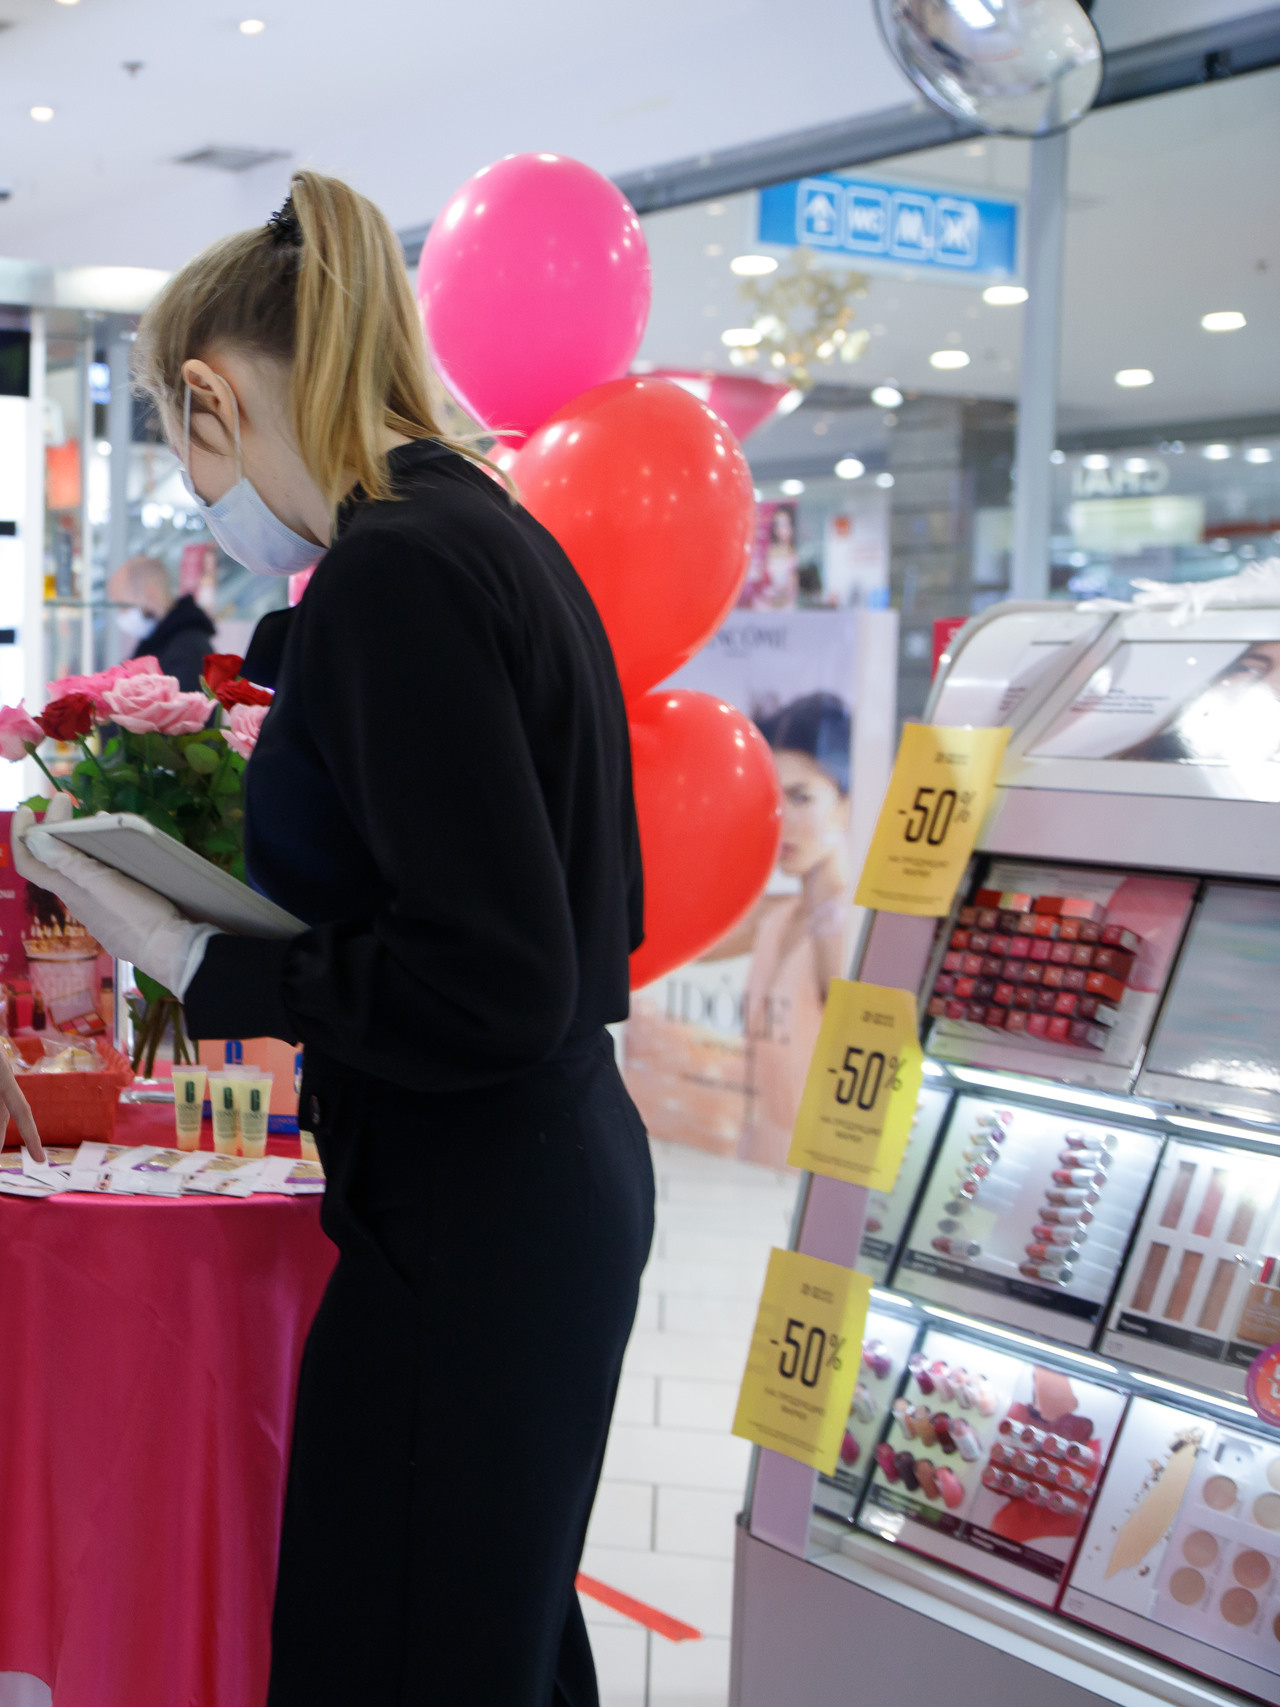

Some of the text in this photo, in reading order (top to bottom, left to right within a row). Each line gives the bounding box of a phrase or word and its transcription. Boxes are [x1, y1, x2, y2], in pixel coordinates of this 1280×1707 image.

[897, 787, 977, 846] -50%
[827, 1046, 908, 1112] -50%
[770, 1318, 847, 1388] -50%
